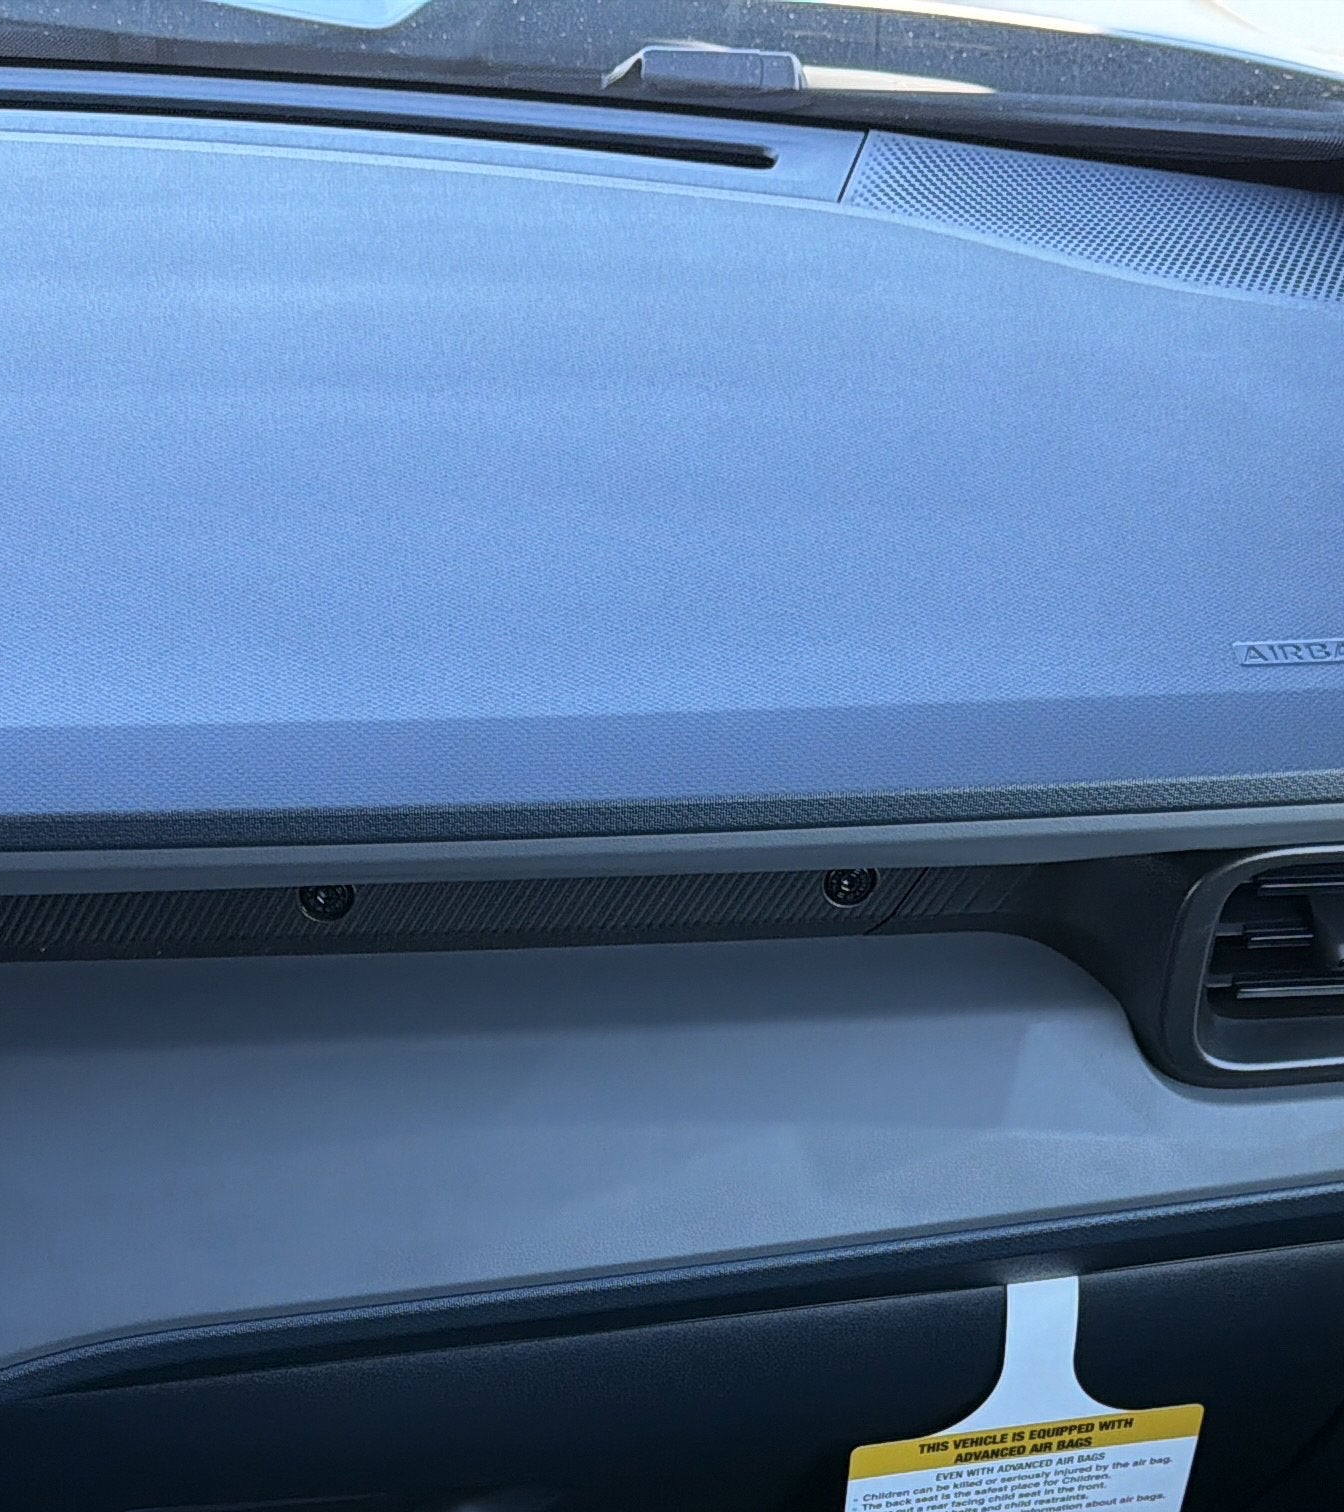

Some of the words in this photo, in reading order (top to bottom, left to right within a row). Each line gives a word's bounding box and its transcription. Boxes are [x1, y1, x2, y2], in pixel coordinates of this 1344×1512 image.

[918, 1440, 949, 1455] THIS
[953, 1432, 1008, 1449] VEHICLE
[1011, 1431, 1025, 1443] IS
[1028, 1422, 1095, 1440] EQUIPPED
[1098, 1417, 1134, 1432] WITH
[954, 1448, 1026, 1464] ADVANCED
[1029, 1442, 1053, 1454] AIR
[1056, 1437, 1093, 1451] BAGS
[862, 1489, 910, 1502] Children
[912, 1487, 933, 1495] can
[936, 1483, 950, 1492] be
[952, 1478, 983, 1490] killed
[1000, 1470, 1051, 1484] seriously
[1054, 1465, 1092, 1477] injured
[1095, 1463, 1108, 1473] by
[1112, 1461, 1129, 1470] the
[1132, 1458, 1146, 1467] air
[1149, 1456, 1172, 1467] bag.
[935, 1470, 963, 1482] EVEN
[966, 1466, 994, 1478] WITH
[997, 1458, 1053, 1473] ADVANCED
[1056, 1456, 1074, 1467] AIR
[1076, 1452, 1106, 1463] BAGS
[861, 1501, 883, 1511] The
[885, 1498, 912, 1508] back
[914, 1494, 938, 1504] seat
[941, 1492, 951, 1500] is
[953, 1490, 972, 1499] the
[974, 1484, 1008, 1496] safest
[1010, 1480, 1040, 1493] place
[1043, 1477, 1060, 1487] for
[1062, 1473, 1112, 1485] Children.
[926, 1502, 948, 1511] rear
[951, 1496, 986, 1509] facing
[987, 1493, 1016, 1503] child
[1018, 1490, 1041, 1499] seat
[1044, 1487, 1055, 1496] in
[1057, 1485, 1075, 1494] the
[980, 1504, 1002, 1512] and
[1004, 1499, 1032, 1510] child
[1085, 1498, 1117, 1508] about
[1119, 1495, 1134, 1505] air
